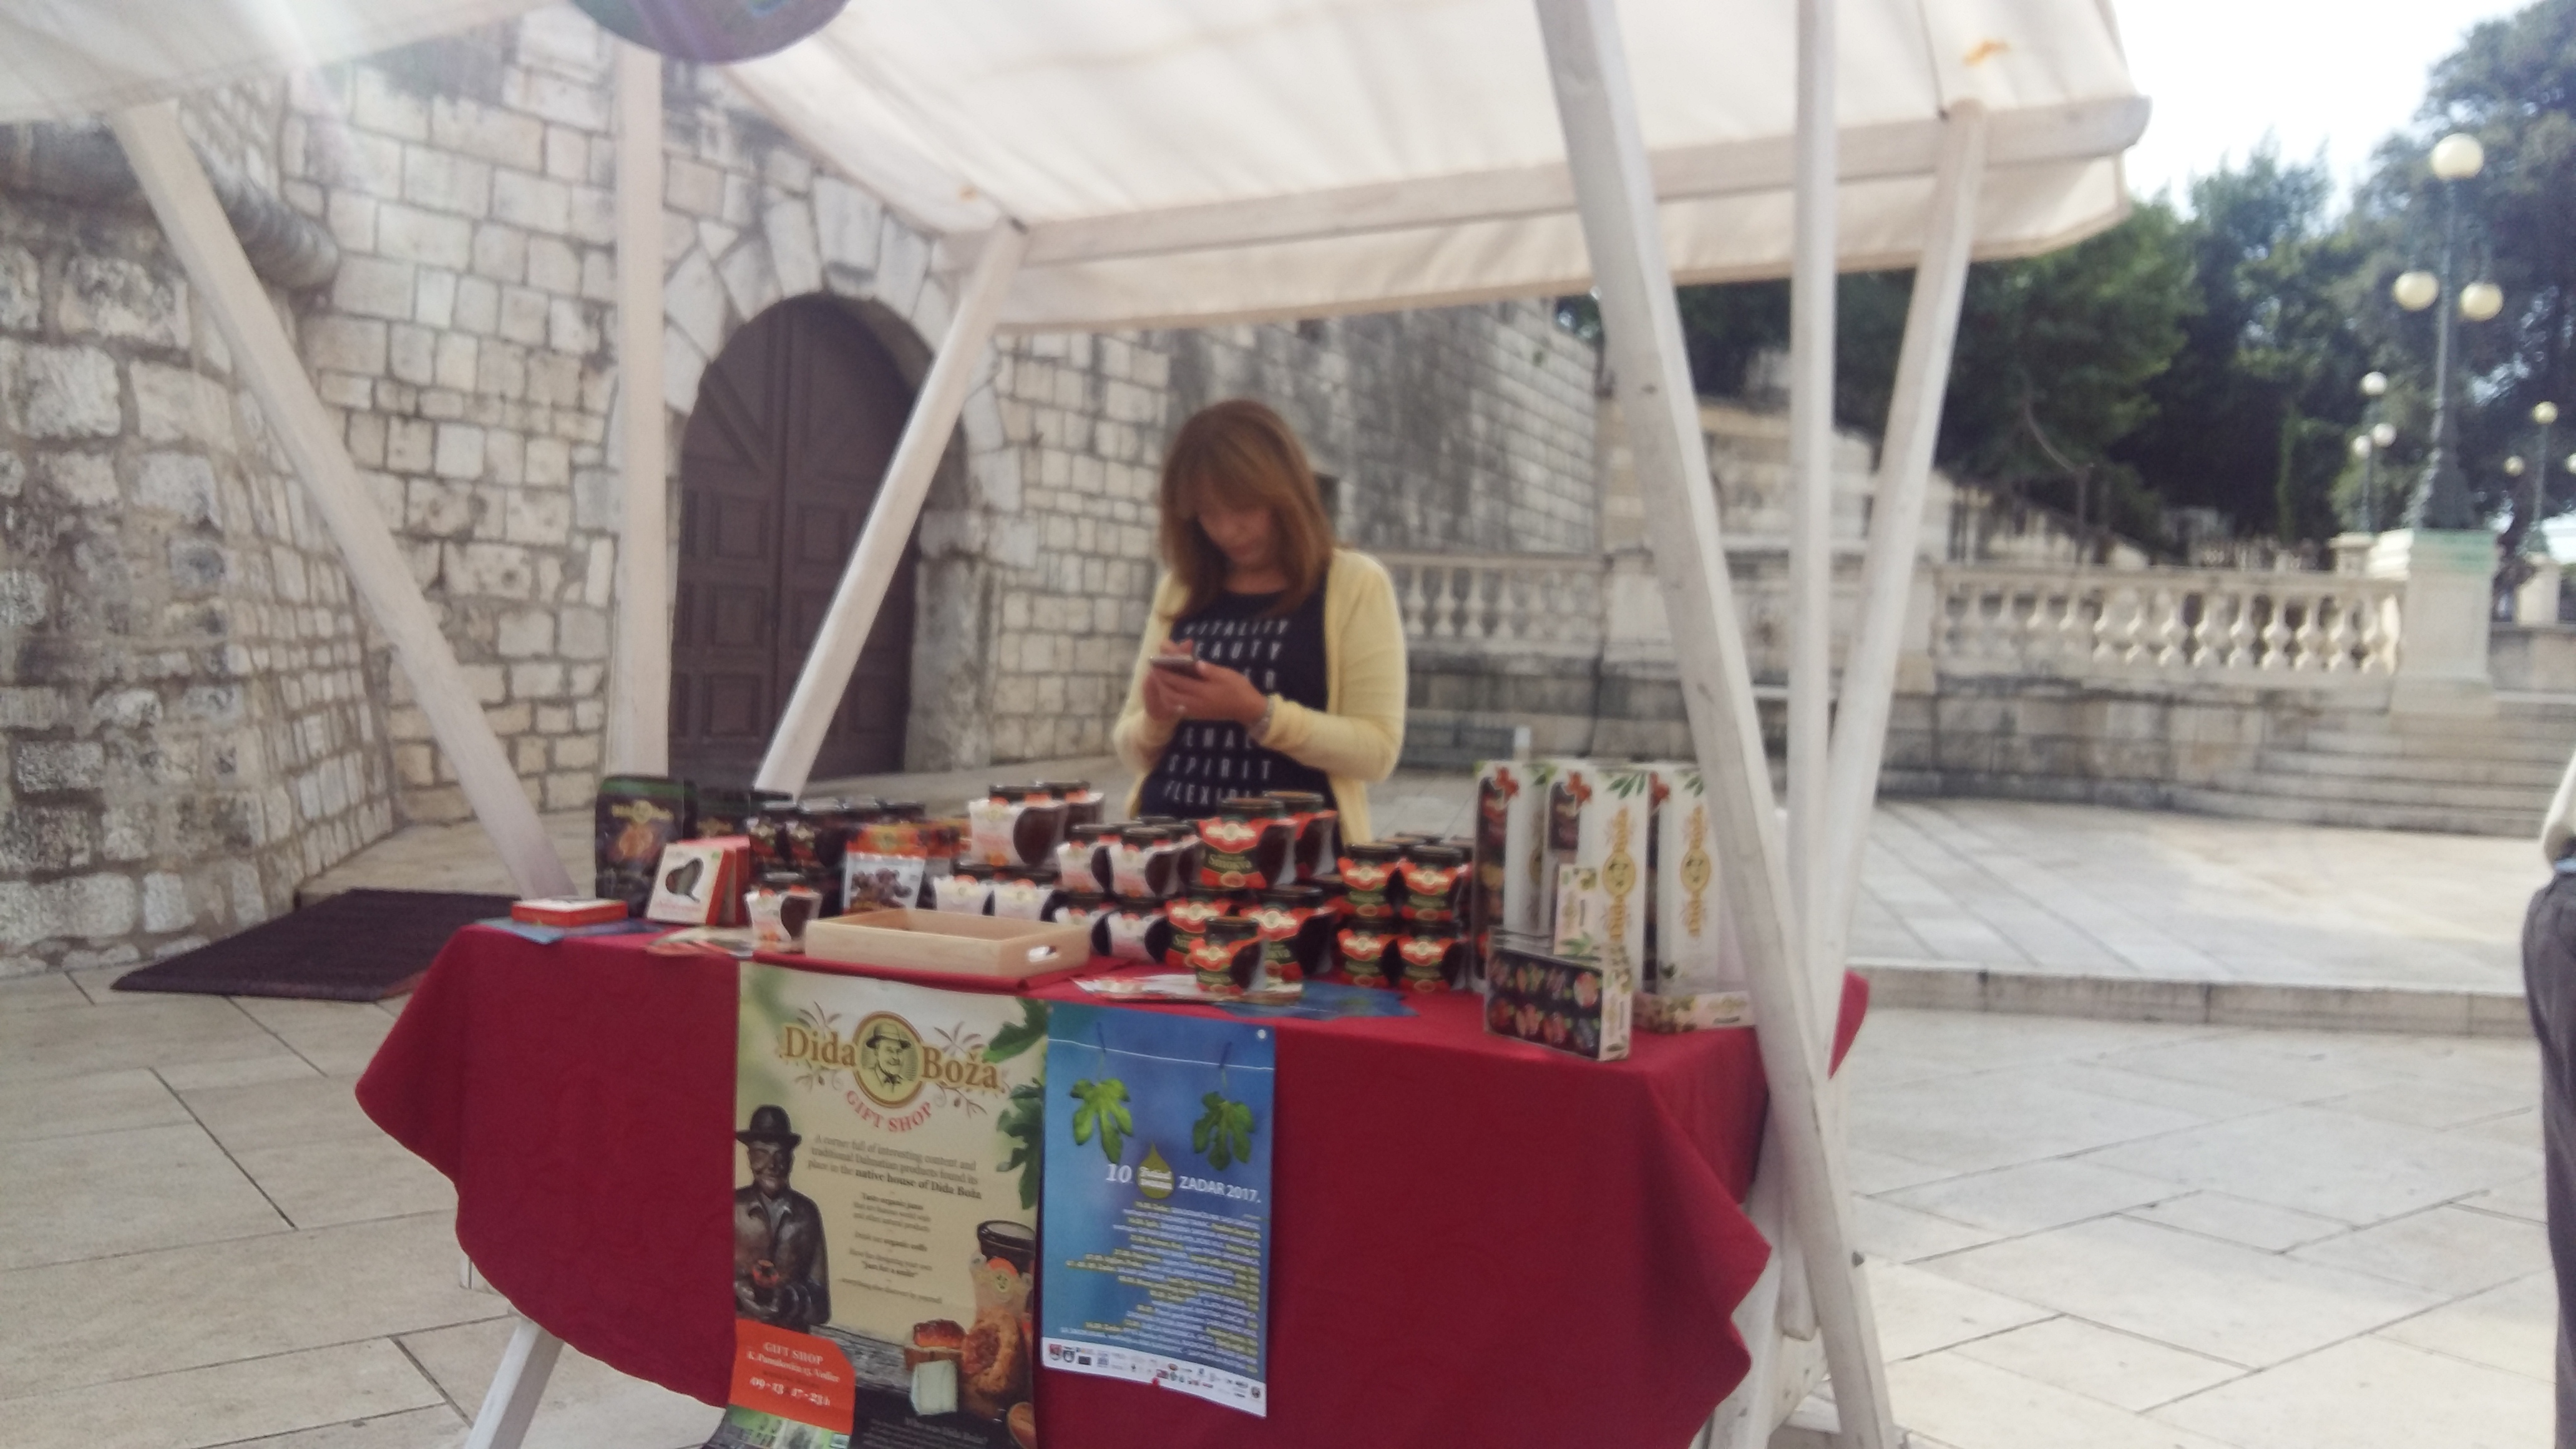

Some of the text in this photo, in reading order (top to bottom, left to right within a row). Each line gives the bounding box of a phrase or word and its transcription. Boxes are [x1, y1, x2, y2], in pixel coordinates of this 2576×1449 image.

[784, 1026, 1000, 1090] Dida Boža
[846, 1090, 933, 1133] GIFT SHOP
[1179, 1175, 1225, 1196] ZADAR
